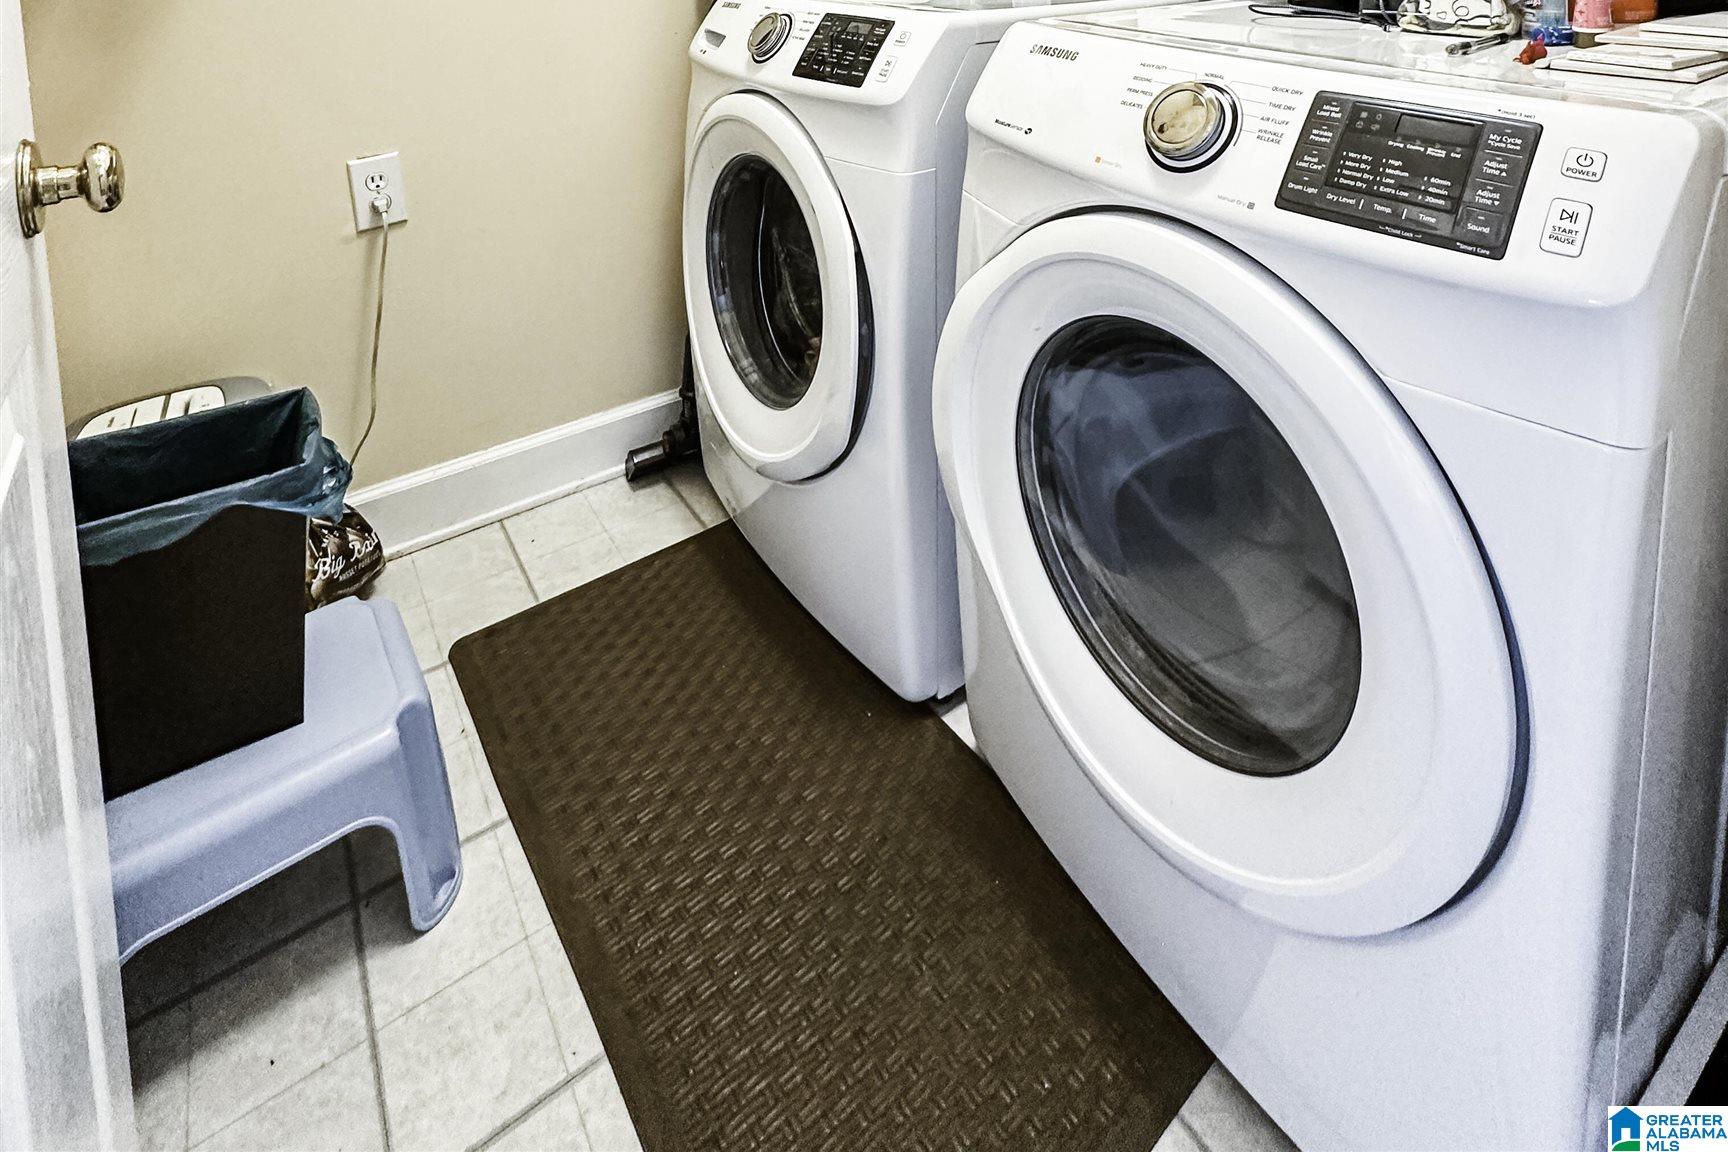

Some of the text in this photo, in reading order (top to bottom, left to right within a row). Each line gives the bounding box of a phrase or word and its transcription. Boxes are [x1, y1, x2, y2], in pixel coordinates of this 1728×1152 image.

[1029, 44, 1079, 61] SAMSUNG
[1271, 86, 1304, 97] QUICK DRY
[1268, 102, 1297, 112] TIME DRY
[1260, 116, 1289, 126] AIR FLUFF
[1257, 128, 1285, 139] WRINKLE
[1488, 133, 1523, 145] My Cycle
[1256, 135, 1282, 145] RELEASE
[1348, 151, 1373, 162] Very Dry
[1295, 160, 1309, 168] Load
[1345, 160, 1371, 171] More Dry
[1388, 159, 1403, 167] High
[1484, 160, 1508, 170] Adjust
[1342, 168, 1374, 181] Normal Dry
[1385, 167, 1409, 177] Medium
[1482, 167, 1500, 176] Time
[1566, 166, 1598, 178] POWER
[1339, 177, 1367, 189] Damp Dry
[1382, 176, 1395, 184] Low
[1430, 177, 1451, 187] 60min
[1287, 182, 1318, 194] Drum Light
[1380, 185, 1410, 197] Extra Low
[1427, 186, 1448, 196] 40min
[1326, 193, 1356, 205] Dry Level
[1476, 189, 1500, 199] Adjust
[1424, 195, 1445, 206] 20min
[1475, 196, 1493, 205] Time
[1419, 213, 1437, 223] Time
[1467, 222, 1490, 234] Sound
[1552, 225, 1579, 236] START
[1549, 233, 1577, 246] PAUSE
[312, 547, 346, 582] Big
